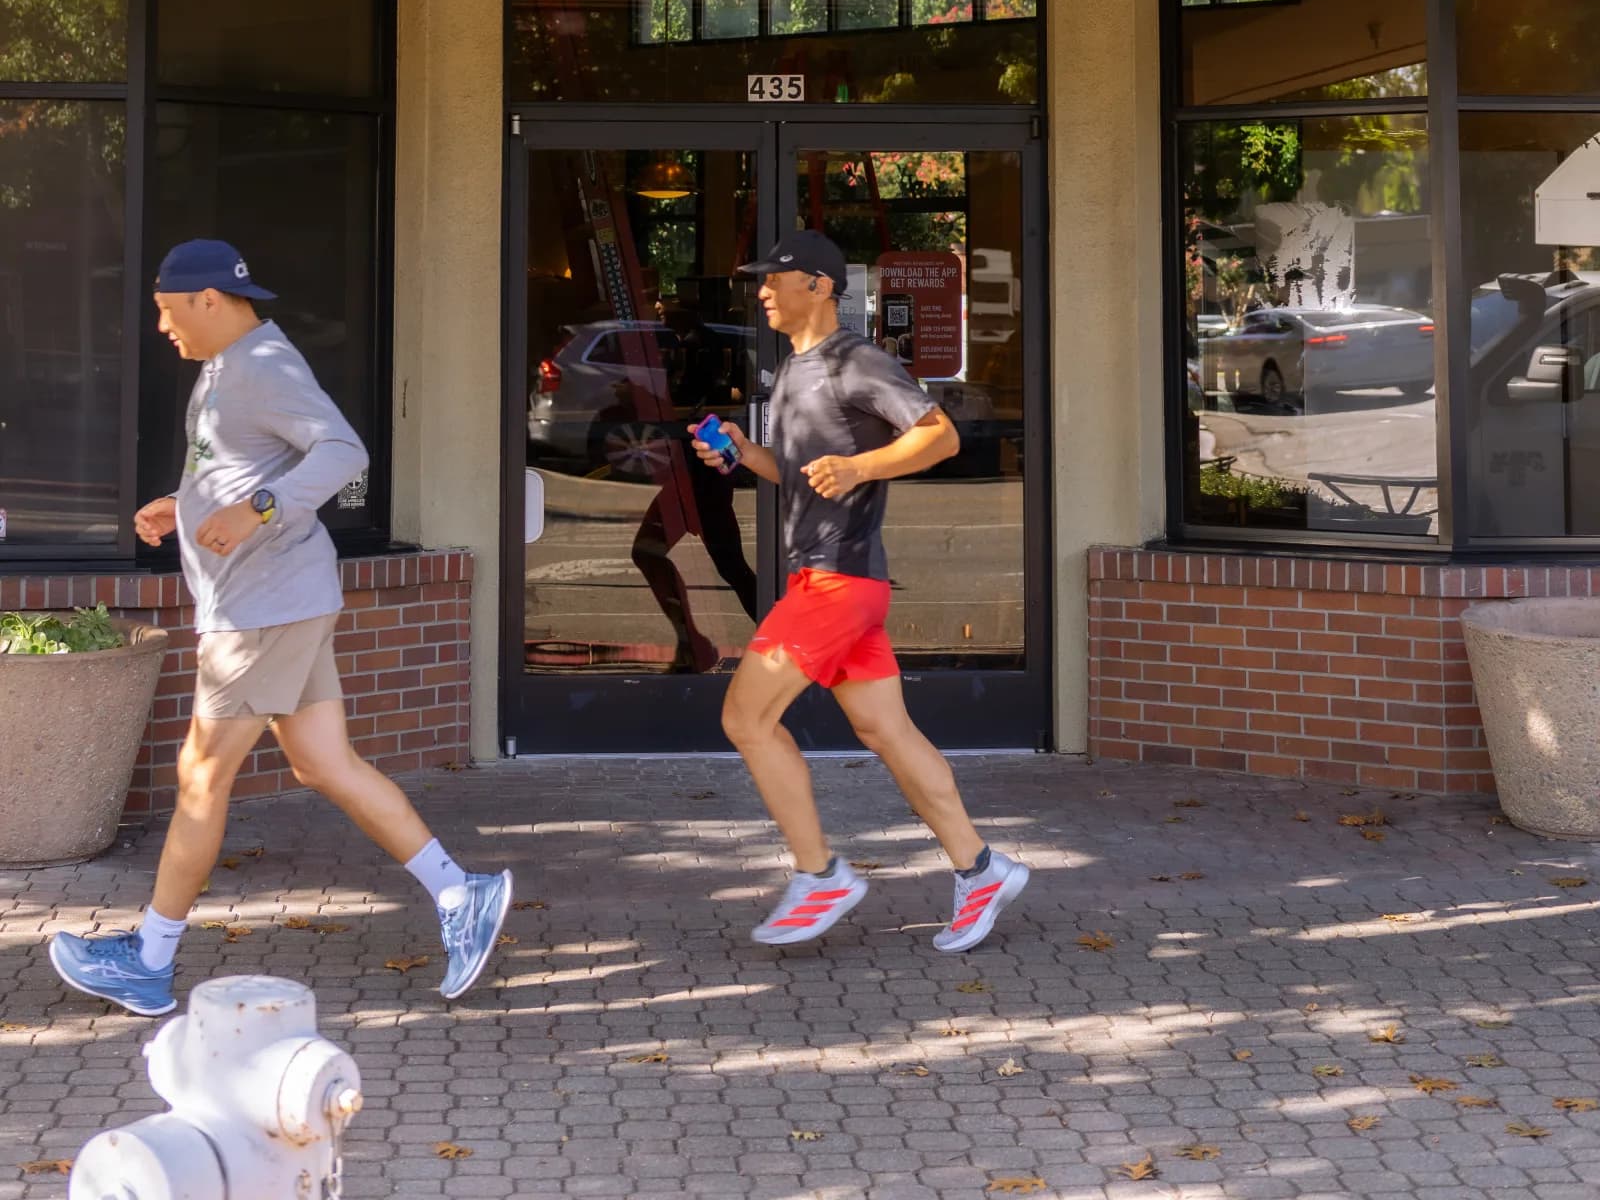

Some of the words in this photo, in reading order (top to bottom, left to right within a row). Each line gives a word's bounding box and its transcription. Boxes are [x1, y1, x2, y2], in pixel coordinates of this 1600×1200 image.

[750, 76, 802, 99] 435
[880, 267, 923, 278] DOWNLOAD
[925, 267, 939, 278] THE
[890, 278, 905, 288] GET
